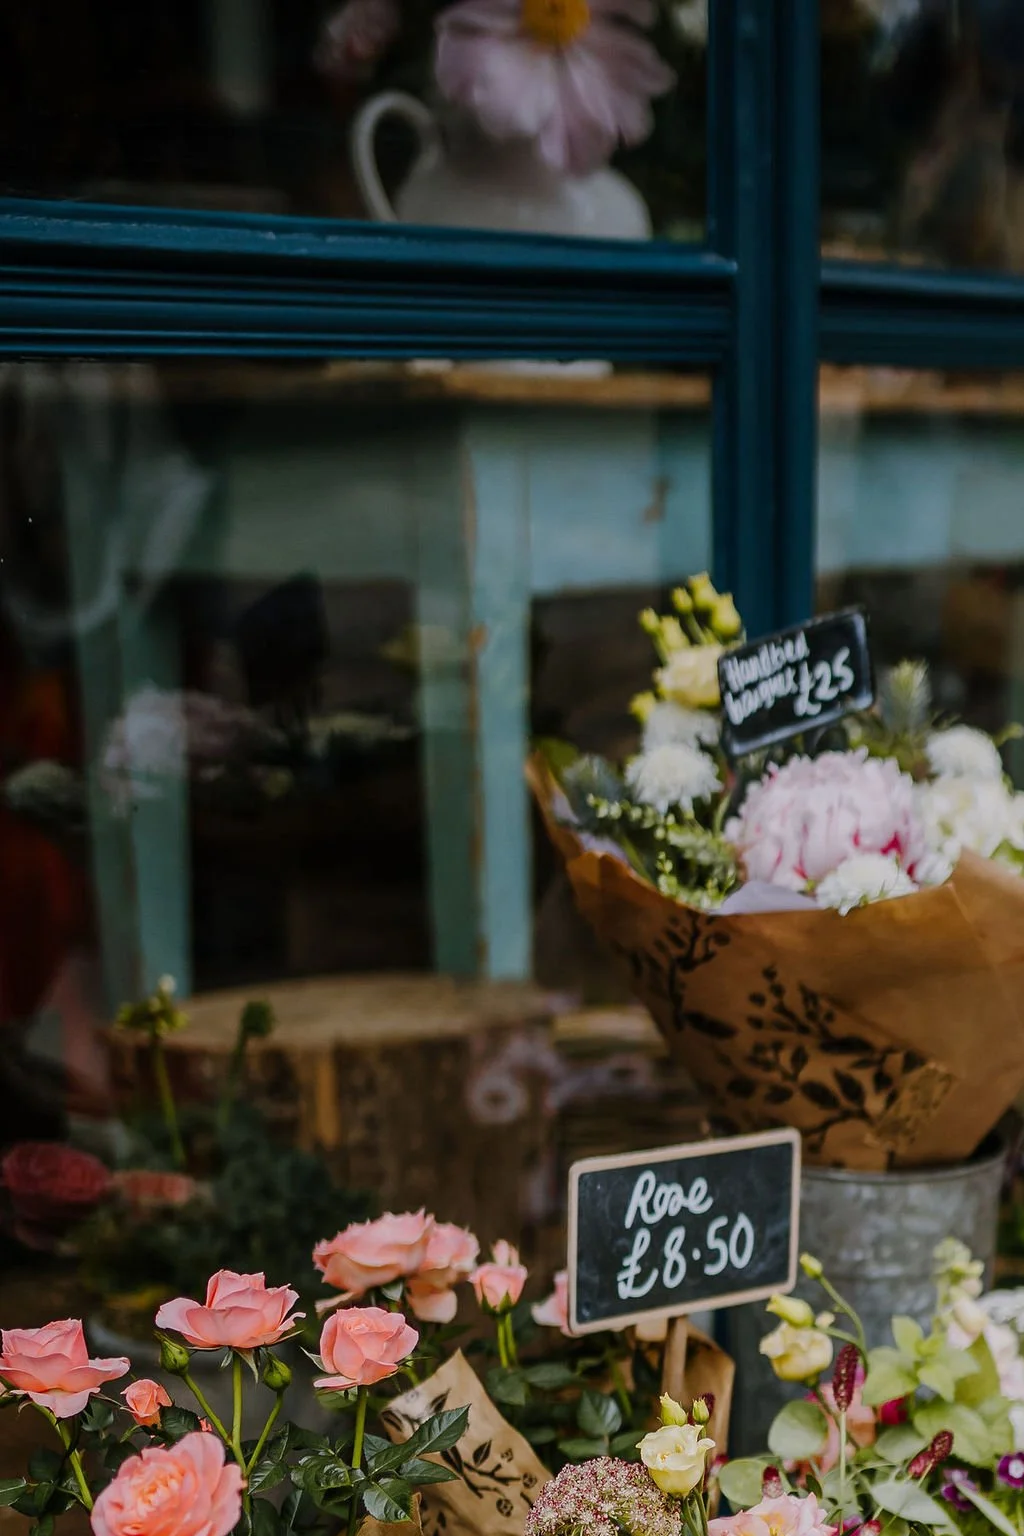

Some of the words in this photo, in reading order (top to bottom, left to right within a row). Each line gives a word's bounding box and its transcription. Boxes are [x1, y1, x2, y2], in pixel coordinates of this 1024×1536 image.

[794, 646, 855, 716] £25
[625, 1170, 714, 1229] Rose
[616, 1212, 755, 1300] £8.50
